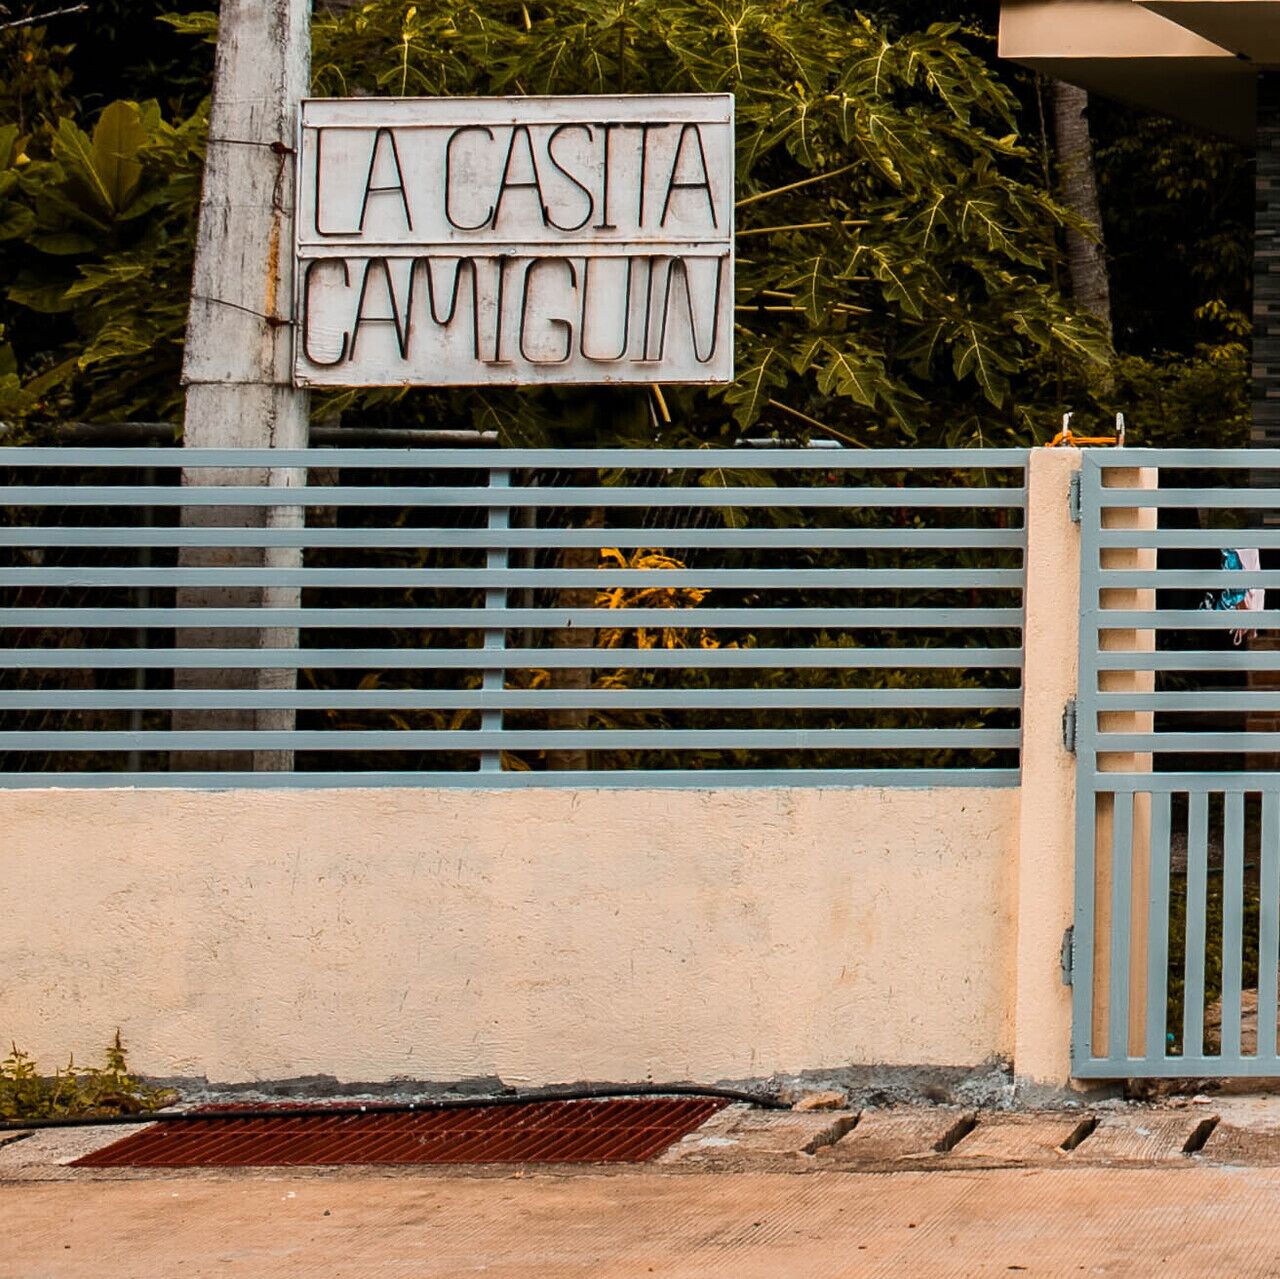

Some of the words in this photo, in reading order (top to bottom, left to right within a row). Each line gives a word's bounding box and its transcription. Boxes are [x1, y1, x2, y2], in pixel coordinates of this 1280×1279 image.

[315, 125, 413, 236] LA
[444, 122, 718, 232] CASITA
[303, 255, 723, 366] CAMIGUIN
